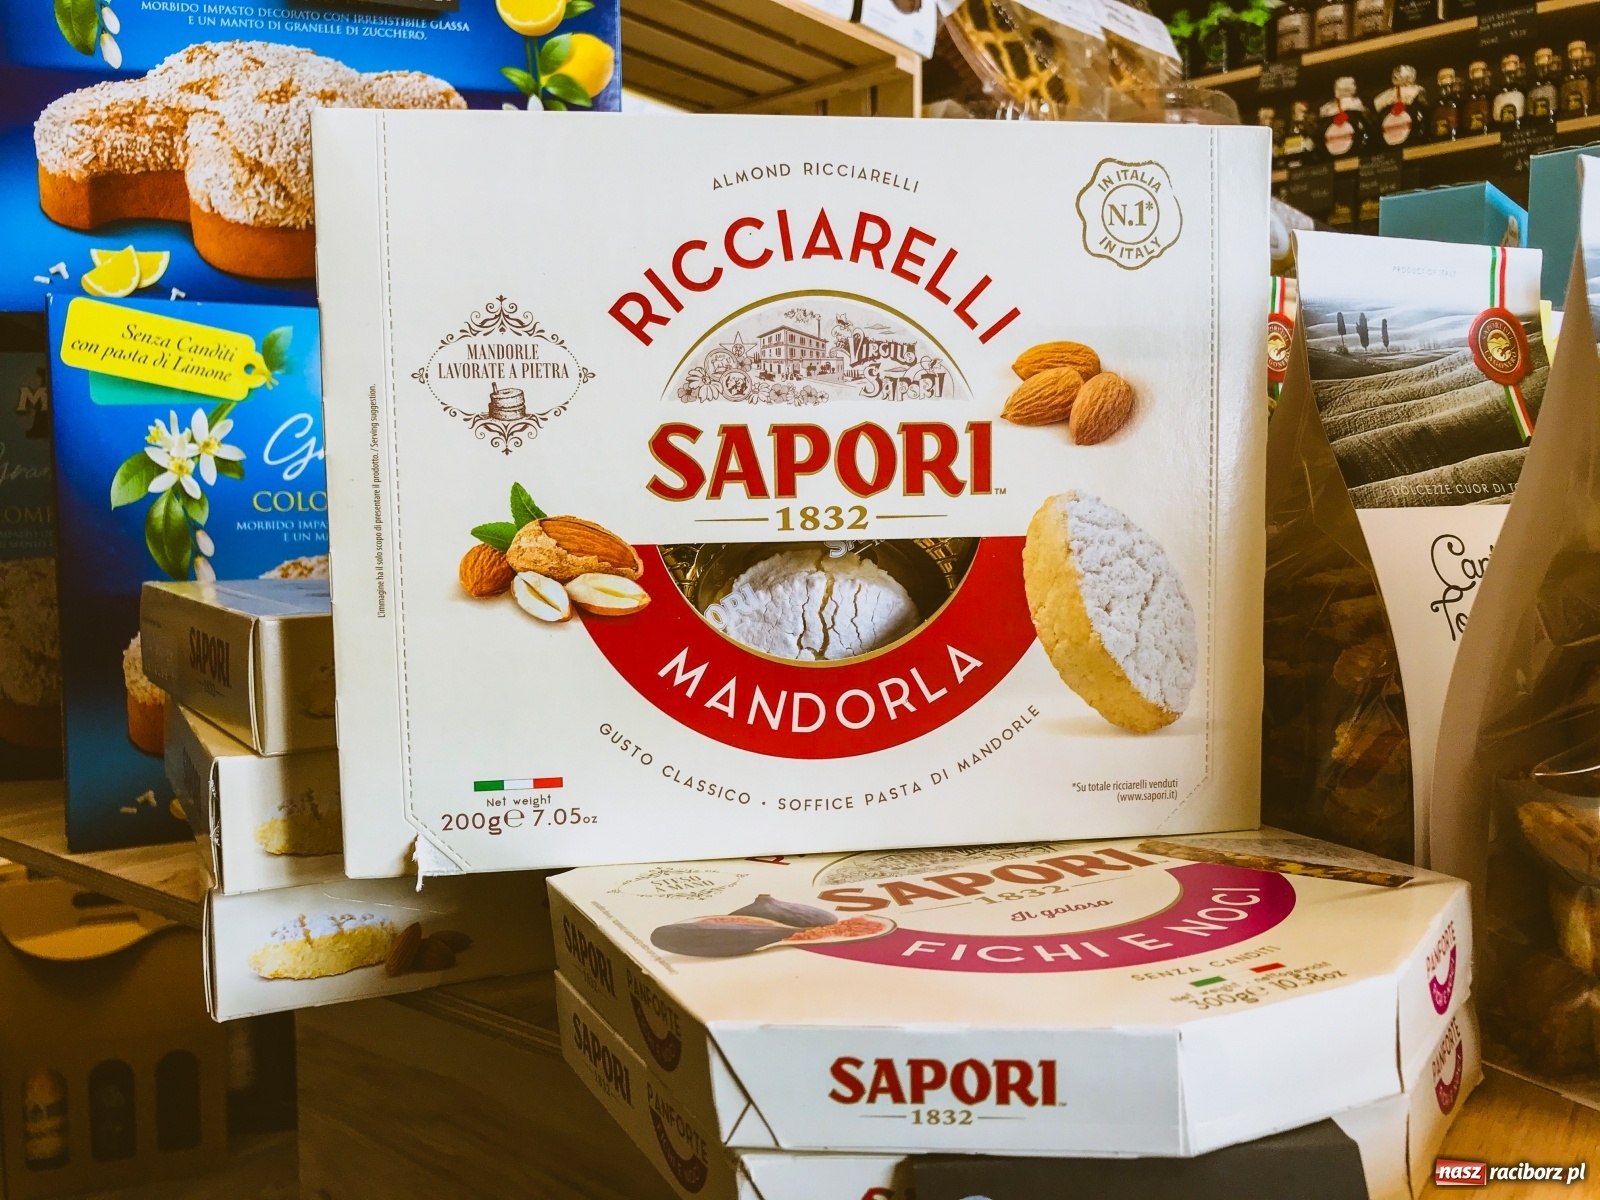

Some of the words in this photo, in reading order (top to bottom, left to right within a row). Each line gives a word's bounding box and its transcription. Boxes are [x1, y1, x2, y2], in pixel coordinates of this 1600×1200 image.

[141, 1, 199, 13] MORBIDO
[203, 4, 254, 16] IMPASTO
[258, 7, 320, 21] DECORATO
[323, 12, 350, 23] CON
[353, 14, 428, 29] IRRESISTIBILE
[430, 20, 471, 32] GLASSA
[188, 15, 195, 25] E
[198, 16, 216, 26] UN
[220, 18, 264, 30] MANTO
[268, 20, 281, 31] DI
[284, 22, 343, 35] GRANELLE
[346, 25, 359, 36] DI
[362, 26, 428, 41] ZUCCHERO.
[712, 163, 791, 190] ALMOND
[803, 162, 919, 193] RICCIARELLI
[1097, 175, 1115, 192] IN
[1116, 169, 1162, 193] ITALIA
[1098, 236, 1117, 254] IN
[1119, 236, 1162, 259] ITALY
[607, 207, 1021, 346] RICCIARELLI
[121, 323, 171, 348] Senza
[176, 336, 238, 363] Canditi
[466, 344, 540, 360] MANDORLE
[70, 339, 99, 354] con
[101, 345, 149, 365] pasta
[152, 352, 172, 369] di
[173, 356, 232, 382] Limone
[437, 362, 506, 379] LAVORATE
[509, 362, 518, 379] A
[521, 362, 570, 379] PIETRA
[860, 363, 946, 401] SAPORI
[367, 384, 379, 421] suggestion.
[369, 422, 380, 447] Serving
[646, 420, 993, 502] SAPORI
[1391, 484, 1452, 496] DOLCEZZE
[1455, 483, 1490, 494] CUOR
[1493, 483, 1506, 493] DI
[372, 489, 383, 524] presentare
[775, 505, 870, 531] 1832
[236, 520, 295, 531] MORBIDO
[283, 532, 290, 542] E
[293, 532, 311, 542] UN
[315, 532, 328, 542] M
[375, 532, 385, 551] scopo
[375, 551, 384, 565] solo
[375, 571, 384, 580] ha
[189, 626, 231, 688] SAPORI
[657, 644, 983, 733] MANDORLA
[599, 722, 654, 766] GUSTO
[661, 765, 751, 805] CLASSICO
[777, 795, 854, 812] SOFFICE
[864, 781, 923, 806] PASTA
[930, 767, 950, 786] DI
[956, 704, 1040, 774] MANDORLE
[1088, 780, 1111, 792] totale
[1112, 779, 1148, 791] ricciarelli
[1149, 778, 1178, 789] venduti
[1116, 789, 1178, 804] (www.sapori.it)
[486, 796, 507, 807] Net
[513, 794, 552, 808] weight
[533, 807, 598, 827] 7.05oz
[651, 875, 702, 887] STESO
[670, 880, 715, 891] MANO
[818, 847, 1160, 912] SAPORI
[974, 885, 1070, 906] 1832
[902, 940, 1109, 963] FICHI
[1117, 932, 1174, 951] E
[1163, 887, 1261, 937] NOCI
[563, 915, 616, 998] SAPORI
[1131, 966, 1202, 981] SENZA
[1209, 945, 1281, 967] CANDITI
[1426, 920, 1456, 977] PANFORTE
[626, 968, 682, 1040] PANFORTE
[573, 1013, 632, 1105] SAPORI
[1432, 1016, 1461, 1081] PANFORTE
[828, 1057, 1057, 1107] SAPORI
[646, 1082, 709, 1165] PANFORTE
[911, 1109, 974, 1126] 1832
